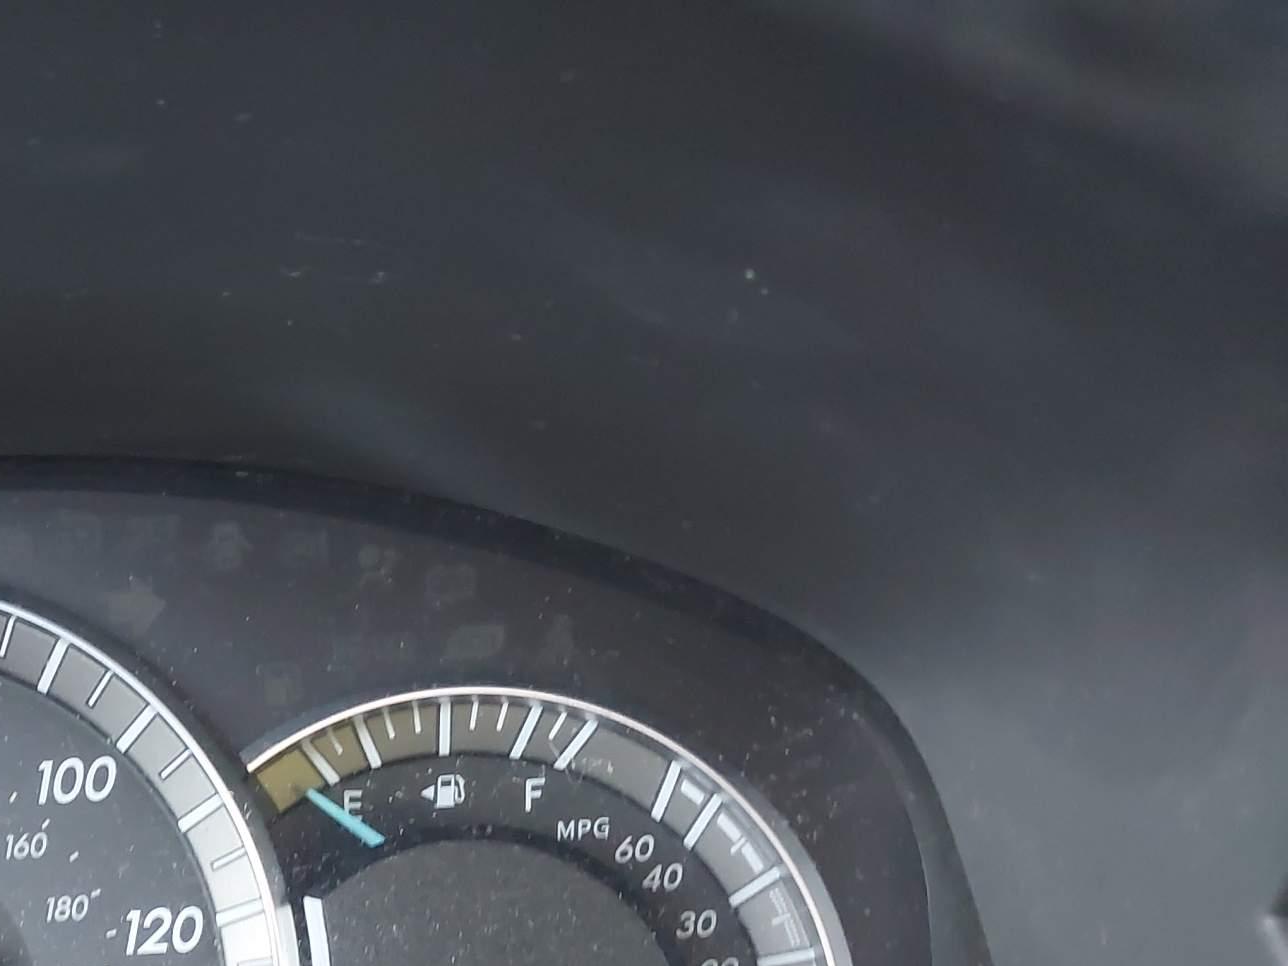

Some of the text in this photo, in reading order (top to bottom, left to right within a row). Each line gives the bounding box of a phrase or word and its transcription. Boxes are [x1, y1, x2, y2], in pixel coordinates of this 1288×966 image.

[37, 756, 117, 805] 100
[525, 777, 546, 812] F
[557, 817, 609, 840] MPG
[5, 832, 48, 860] 160
[614, 834, 655, 863] 60
[642, 863, 683, 892] 40
[46, 894, 89, 923] 180
[125, 905, 204, 956] 120
[676, 909, 717, 939] 30
